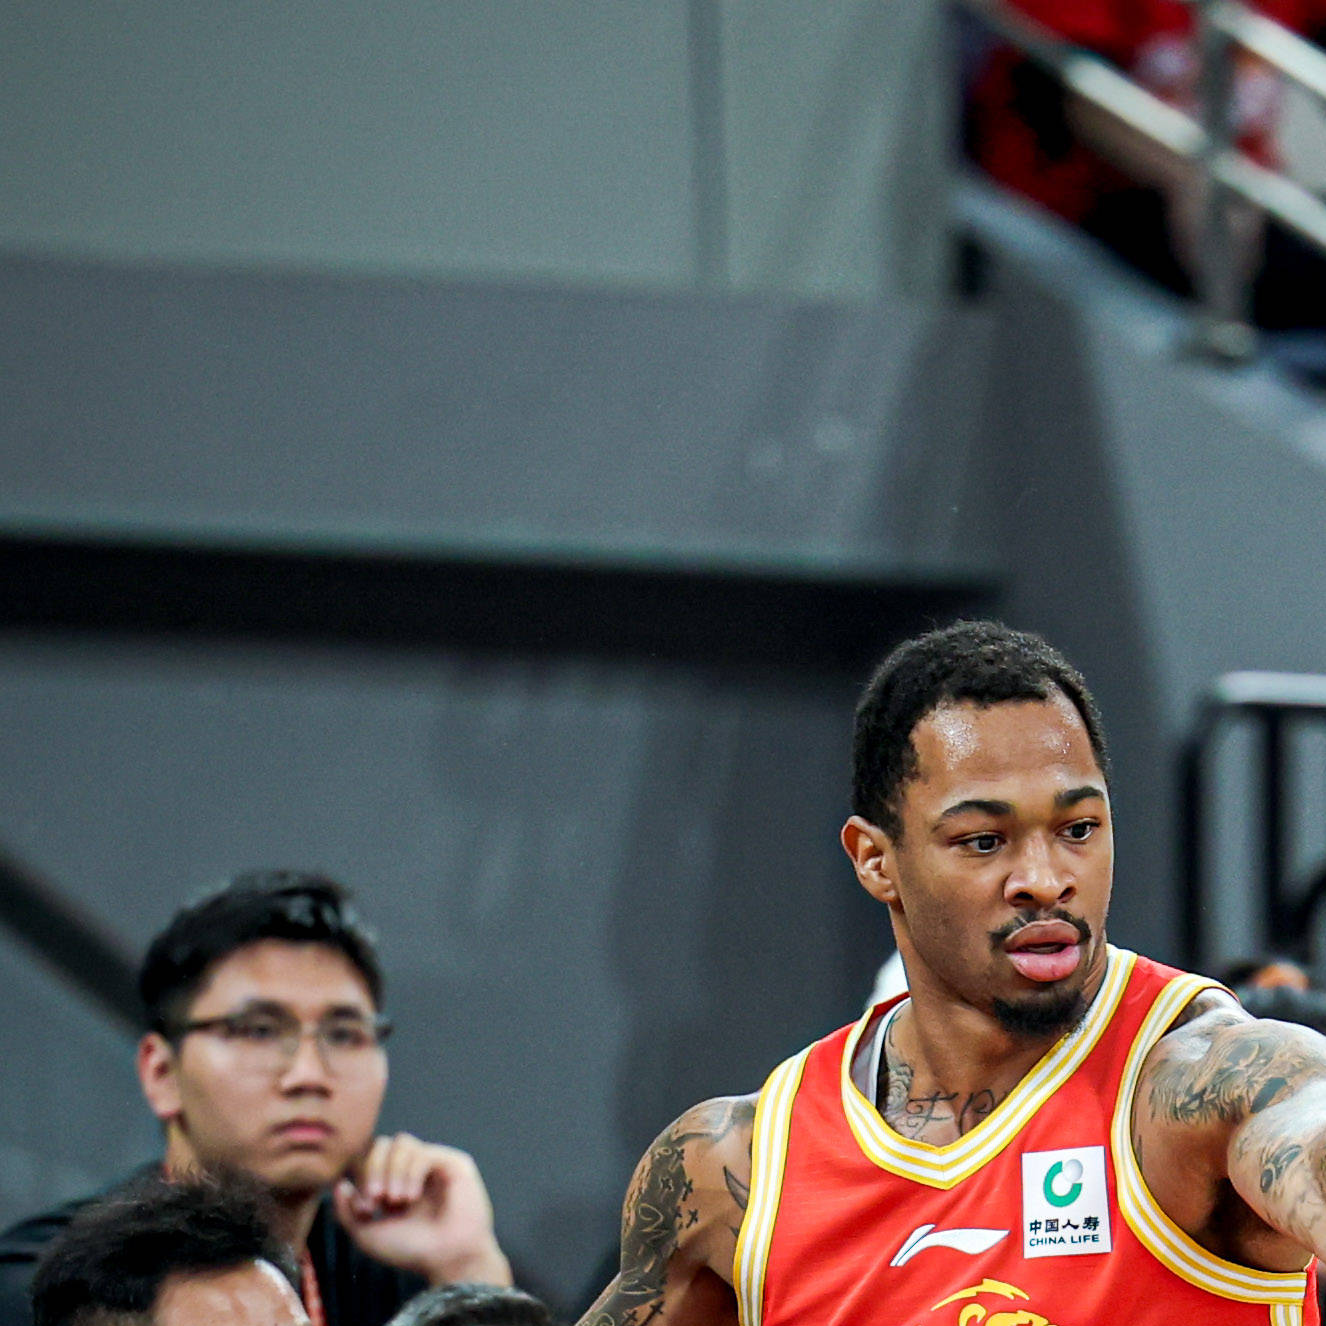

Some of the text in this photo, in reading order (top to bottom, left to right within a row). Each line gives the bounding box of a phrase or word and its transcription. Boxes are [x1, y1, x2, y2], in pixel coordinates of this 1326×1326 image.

[1029, 1216, 1100, 1235] 中国人寿
[1029, 1234, 1100, 1247] CHINA LIFE
